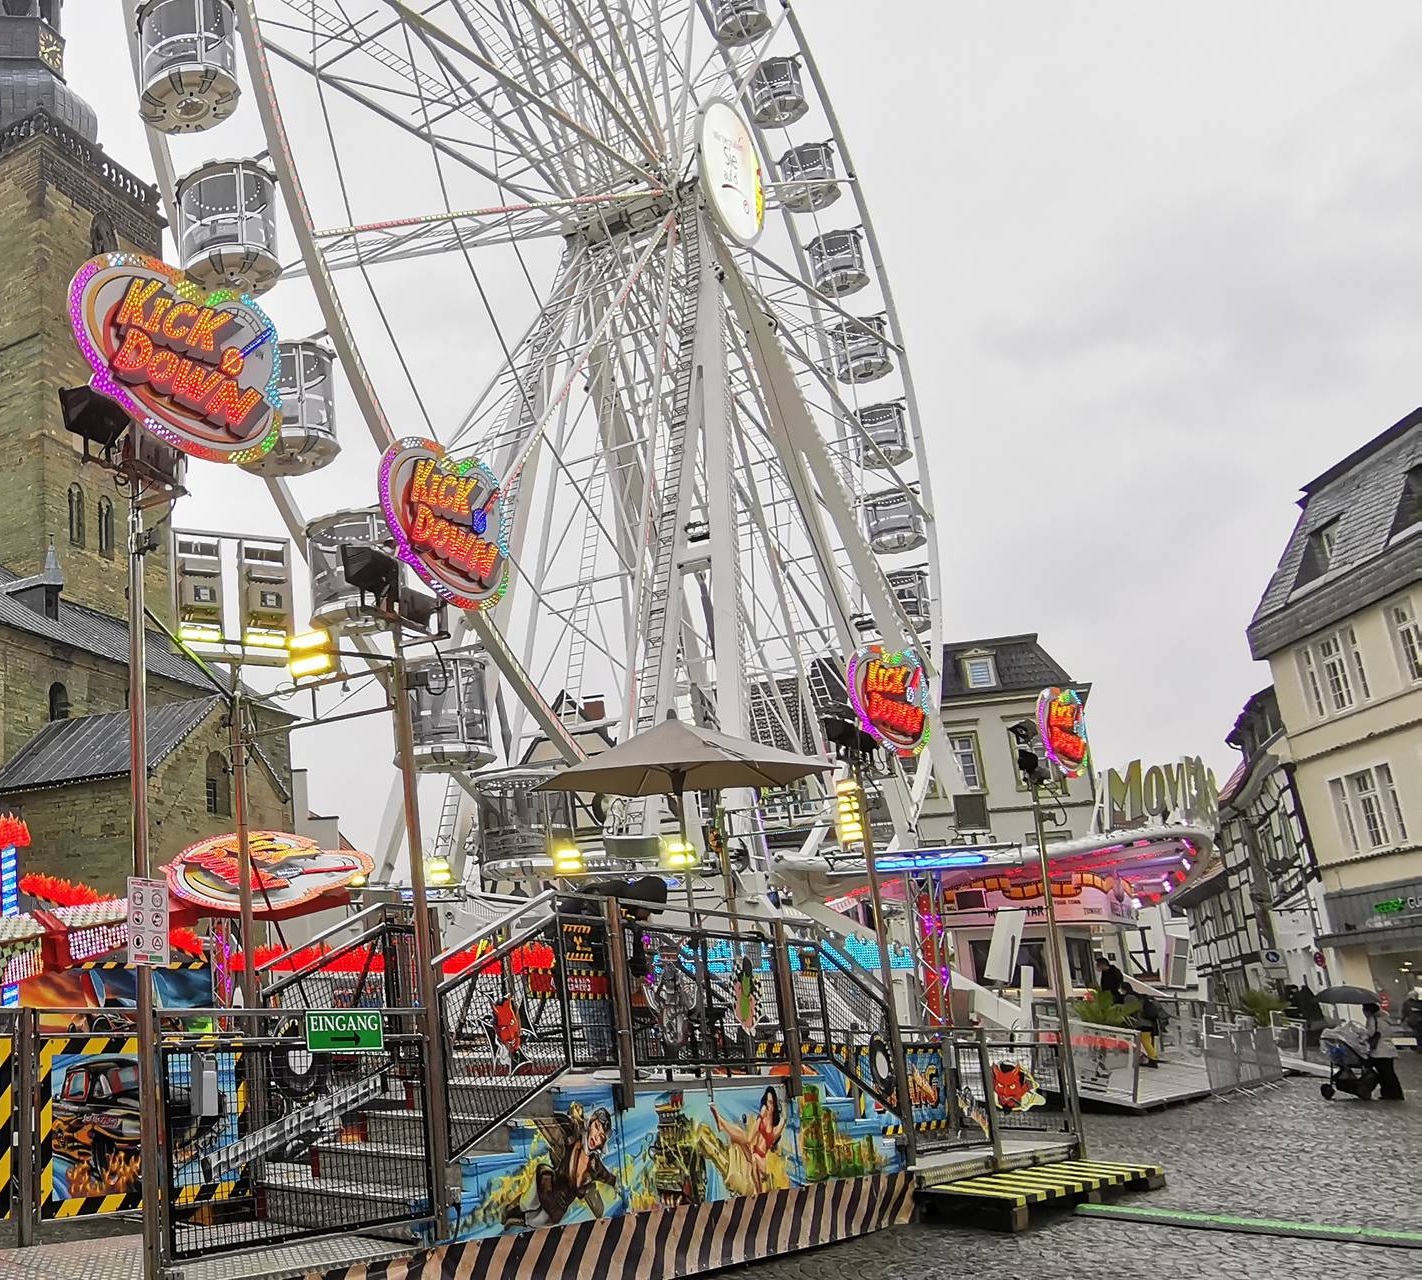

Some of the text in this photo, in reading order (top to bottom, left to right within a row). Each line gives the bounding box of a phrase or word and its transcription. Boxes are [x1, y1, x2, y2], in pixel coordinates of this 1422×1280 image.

[116, 278, 234, 352] KICK
[114, 328, 264, 424] DOWN
[411, 459, 479, 514] KICK
[411, 503, 499, 577] DOWN
[310, 1015, 378, 1032] EINGANG
